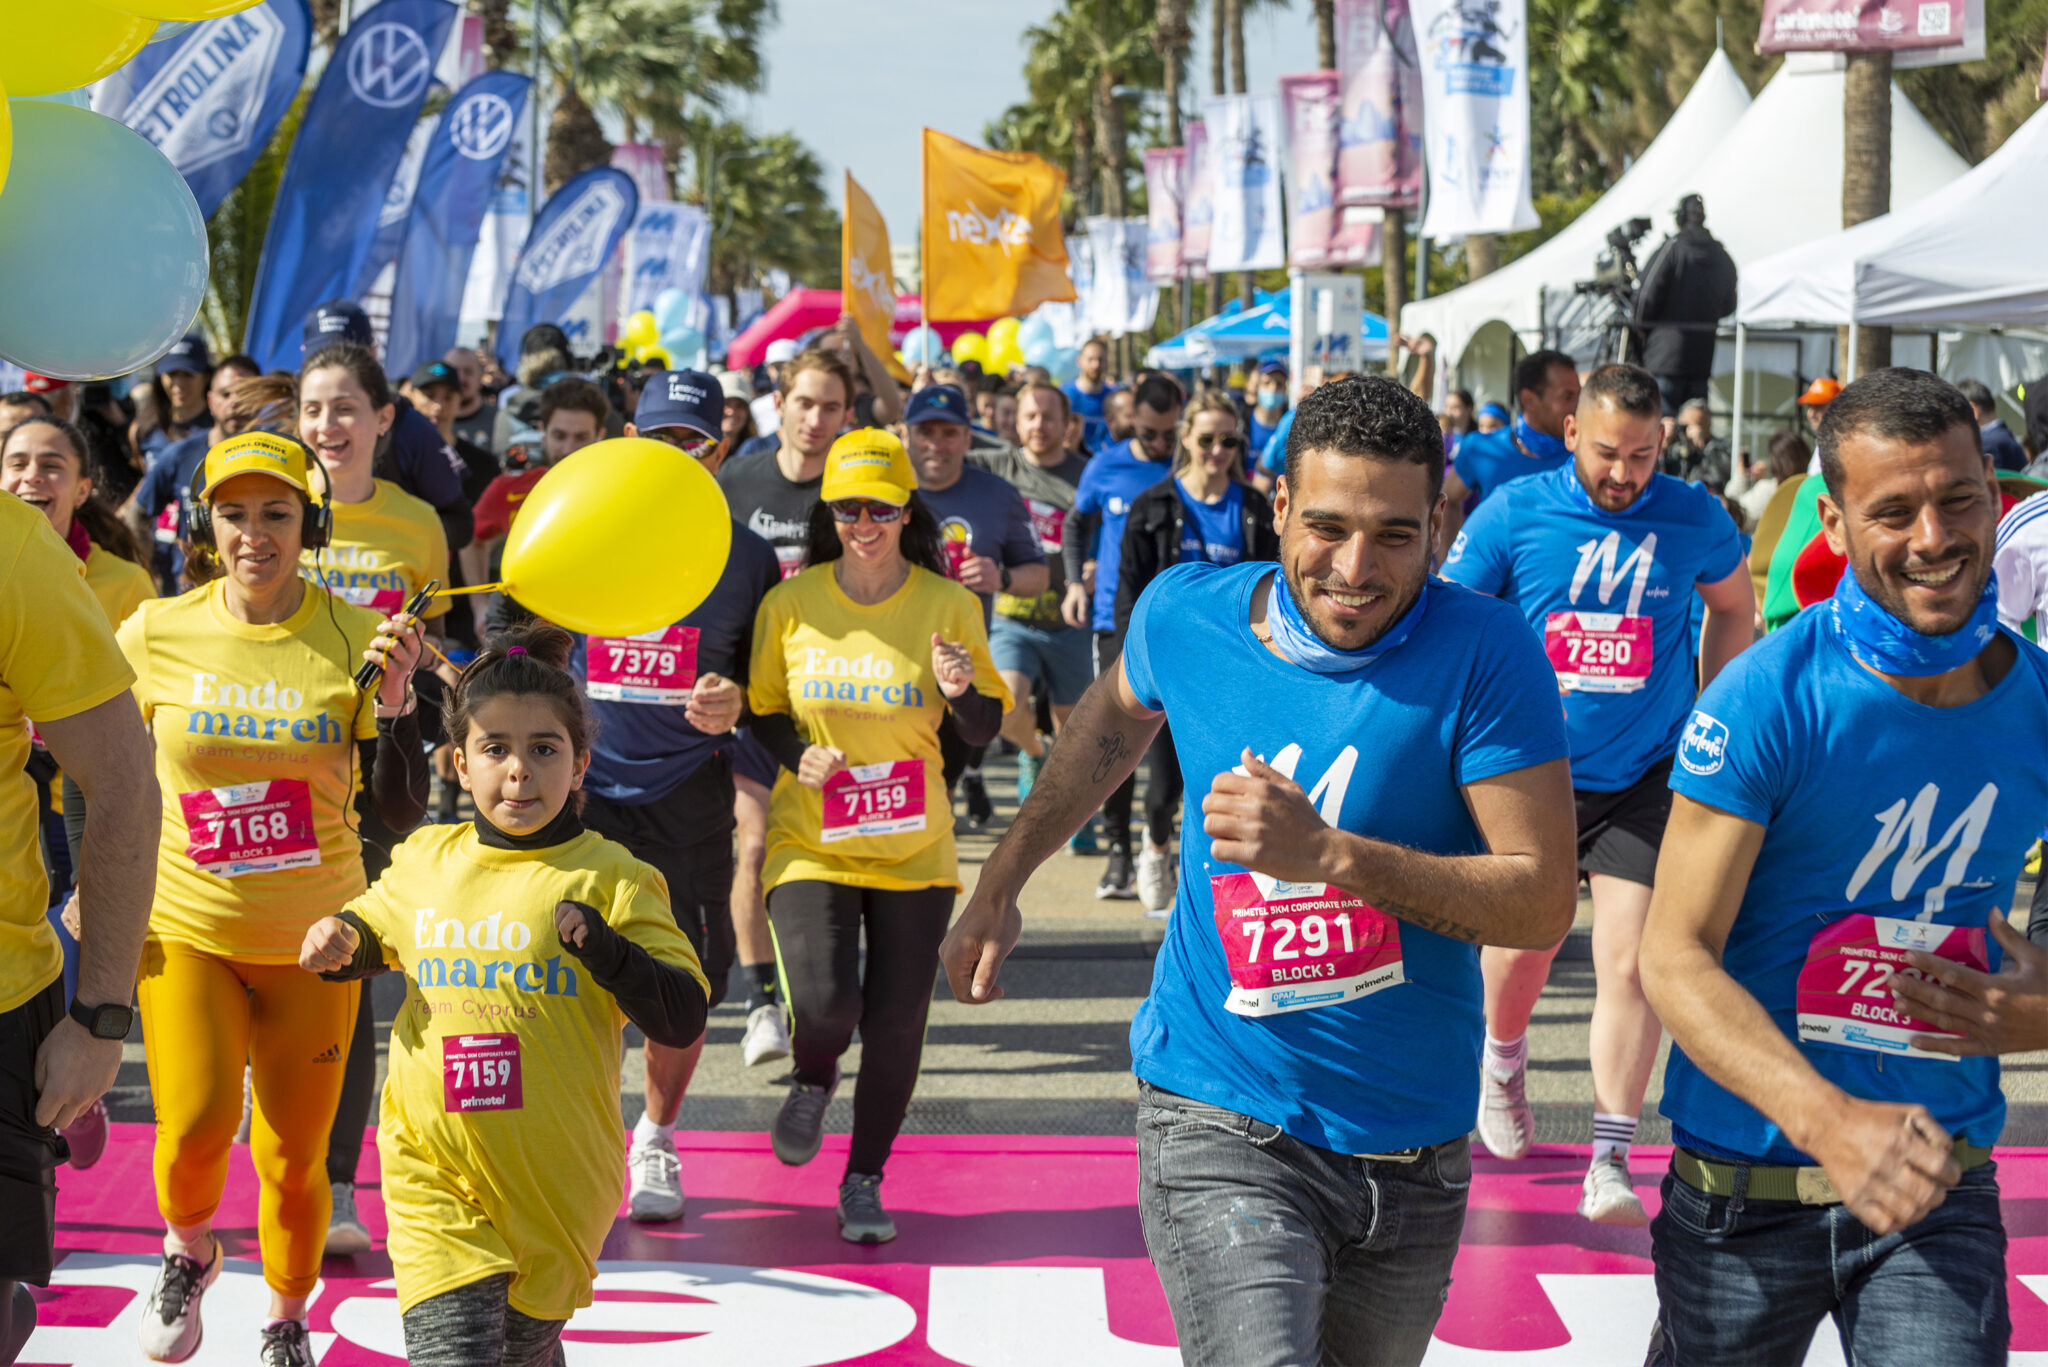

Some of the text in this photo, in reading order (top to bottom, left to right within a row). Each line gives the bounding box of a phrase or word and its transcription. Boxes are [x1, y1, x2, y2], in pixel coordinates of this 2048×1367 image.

[134, 14, 260, 147] ETROLINA
[608, 647, 676, 677] 7379
[804, 647, 894, 680] Endo
[1566, 638, 1631, 665] 7290
[622, 675, 651, 686] BLOCK
[1579, 664, 1615, 675] BLOCK 3
[190, 672, 302, 711] Endo
[802, 680, 924, 708] march
[186, 711, 341, 744] march
[844, 707, 896, 722] Cyprus
[185, 741, 309, 764] Team Cyprus
[844, 785, 907, 817] 7159
[207, 811, 290, 849] 7168
[229, 846, 273, 860] BLOCK 3
[1232, 899, 1364, 918] PRIMETEL 5KM CORPORATE RACE
[415, 907, 531, 951] Endo
[1242, 912, 1354, 963] 7291
[1840, 946, 1878, 960] PRIMETEL
[1879, 951, 1897, 961] 5KM
[417, 954, 579, 997] march
[1271, 963, 1335, 982] BLOCK 3
[1355, 971, 1393, 992] primetel
[414, 999, 537, 1019] Team Cyprus
[1851, 1002, 1899, 1023] BLOCK
[452, 1059, 511, 1089] 7159
[461, 1093, 506, 1109] primetel
